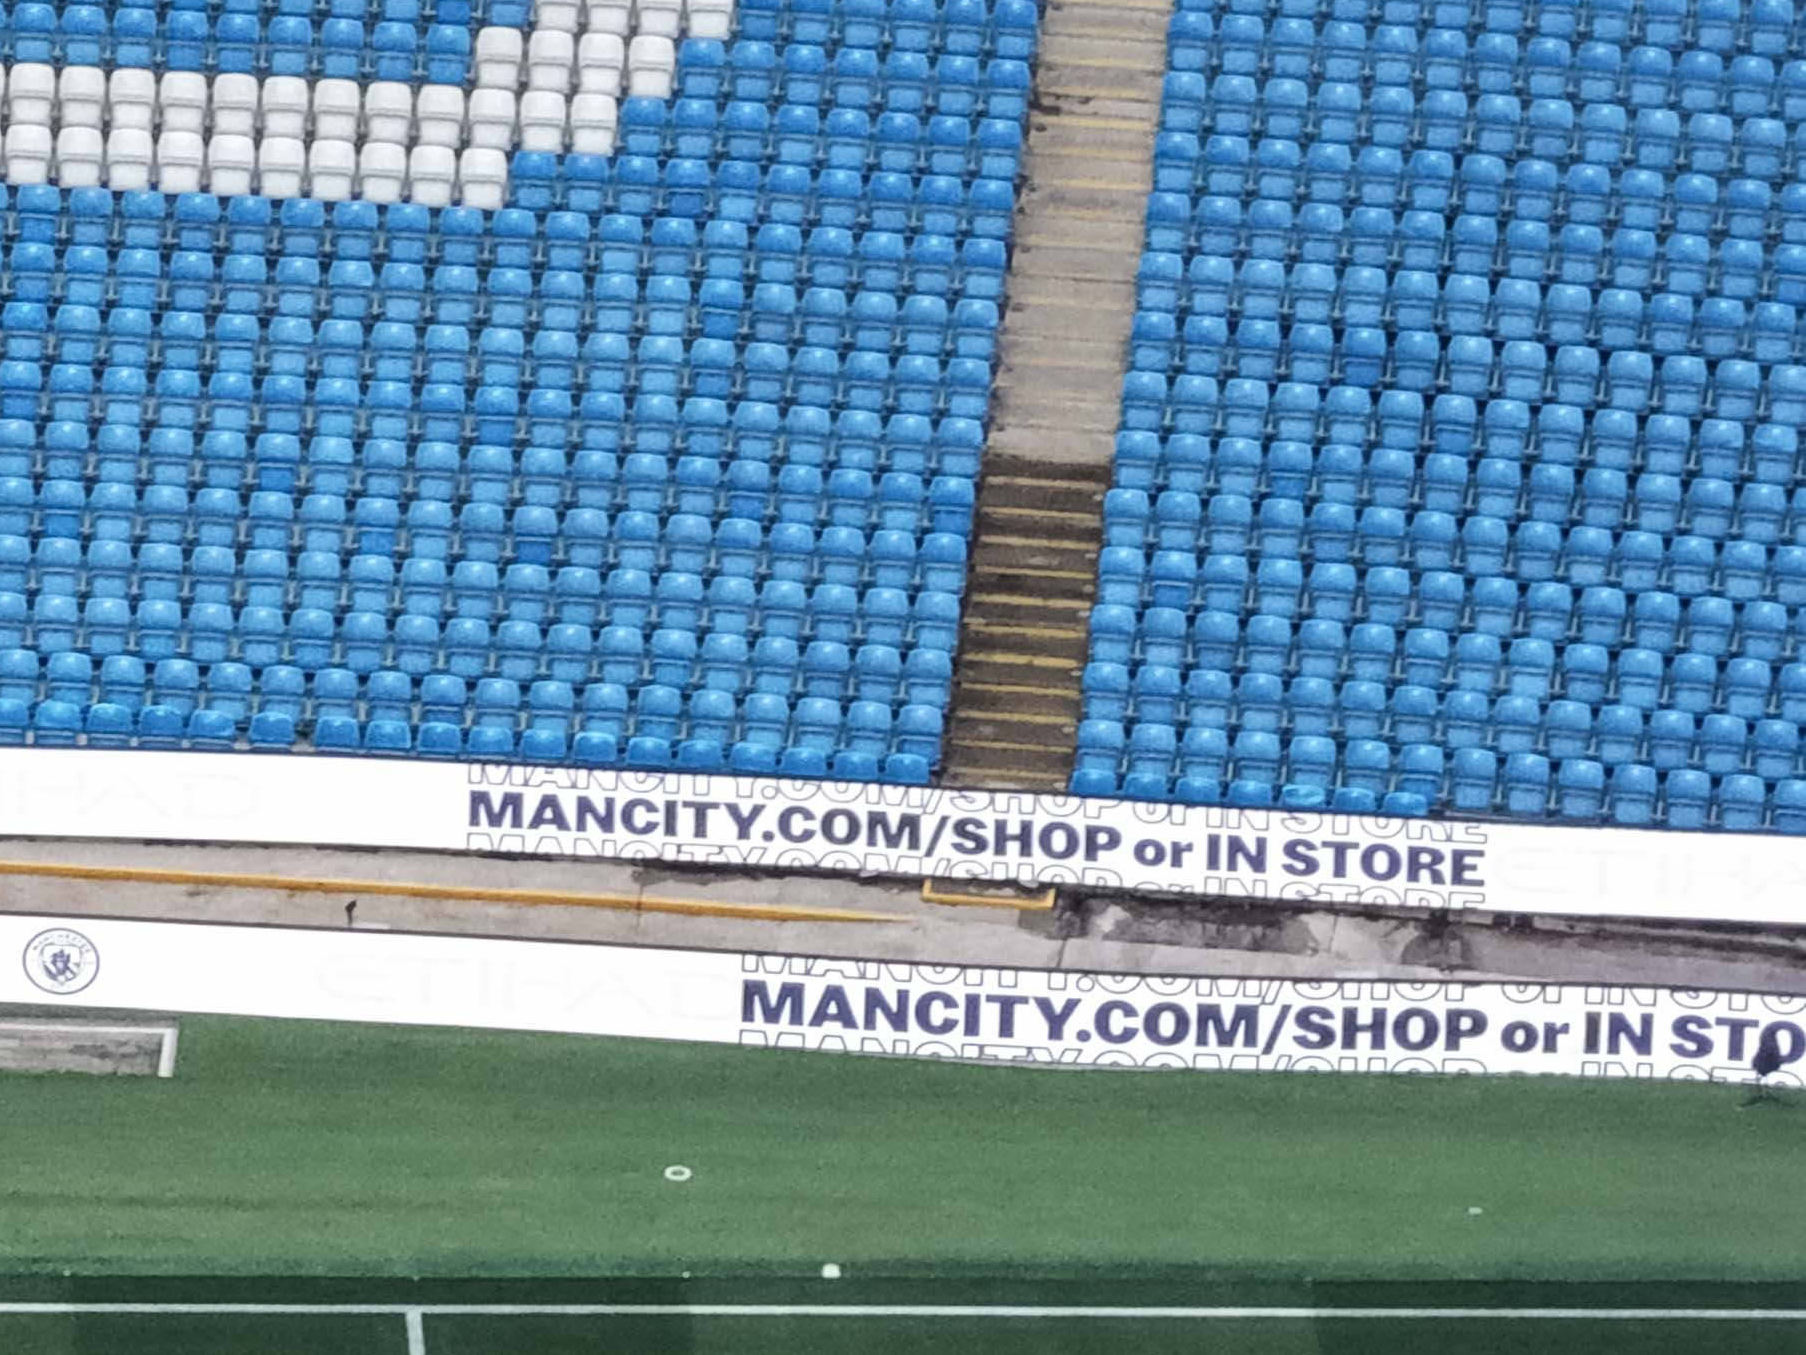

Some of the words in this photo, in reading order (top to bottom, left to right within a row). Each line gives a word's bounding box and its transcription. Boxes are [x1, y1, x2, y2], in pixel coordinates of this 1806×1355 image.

[469, 791, 1123, 864] MANCITY.COM/SHOP
[1134, 839, 1195, 870] or
[1207, 834, 1269, 874] IN
[1283, 839, 1485, 889] STORE
[742, 980, 1489, 1056] MANCITY.COM/SHOP
[1501, 1020, 1571, 1054] or
[1584, 1012, 1655, 1056] IN
[1669, 1015, 1806, 1066] STO
